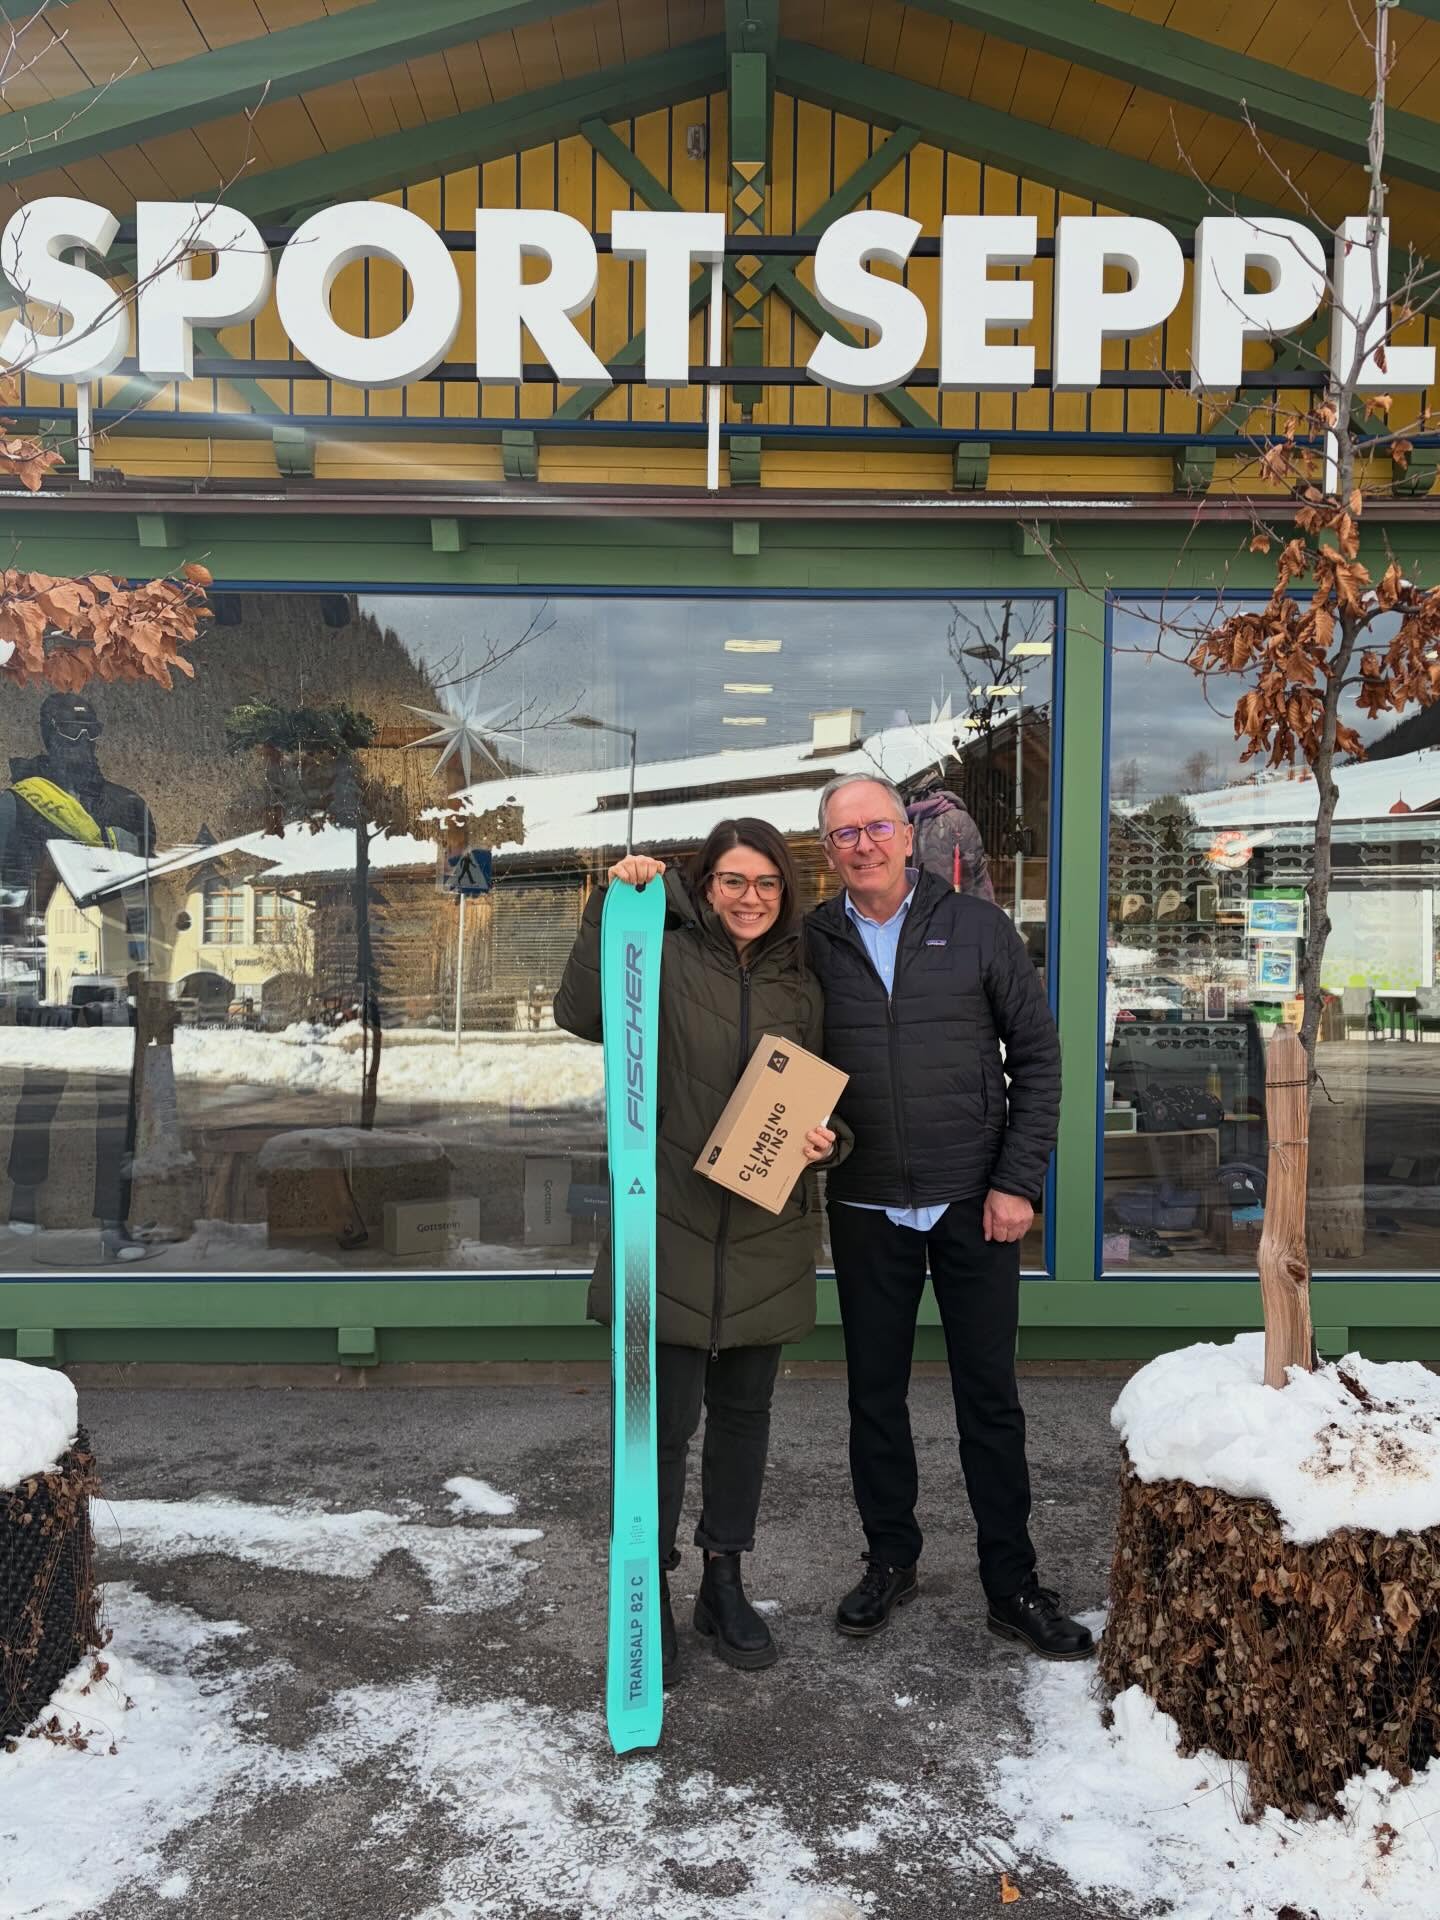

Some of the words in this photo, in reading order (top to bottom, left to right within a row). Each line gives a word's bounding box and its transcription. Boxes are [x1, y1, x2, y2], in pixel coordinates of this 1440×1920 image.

[0, 197, 726, 390] SPORT
[806, 209, 1437, 395] SEPPL
[625, 942, 645, 1133] FISCHER
[738, 1102, 787, 1182] CLIMBING
[755, 1127, 789, 1178] SKINS
[630, 1575, 644, 1587] C
[630, 1591, 644, 1613] 82
[629, 1618, 644, 1702] TRANSALP
